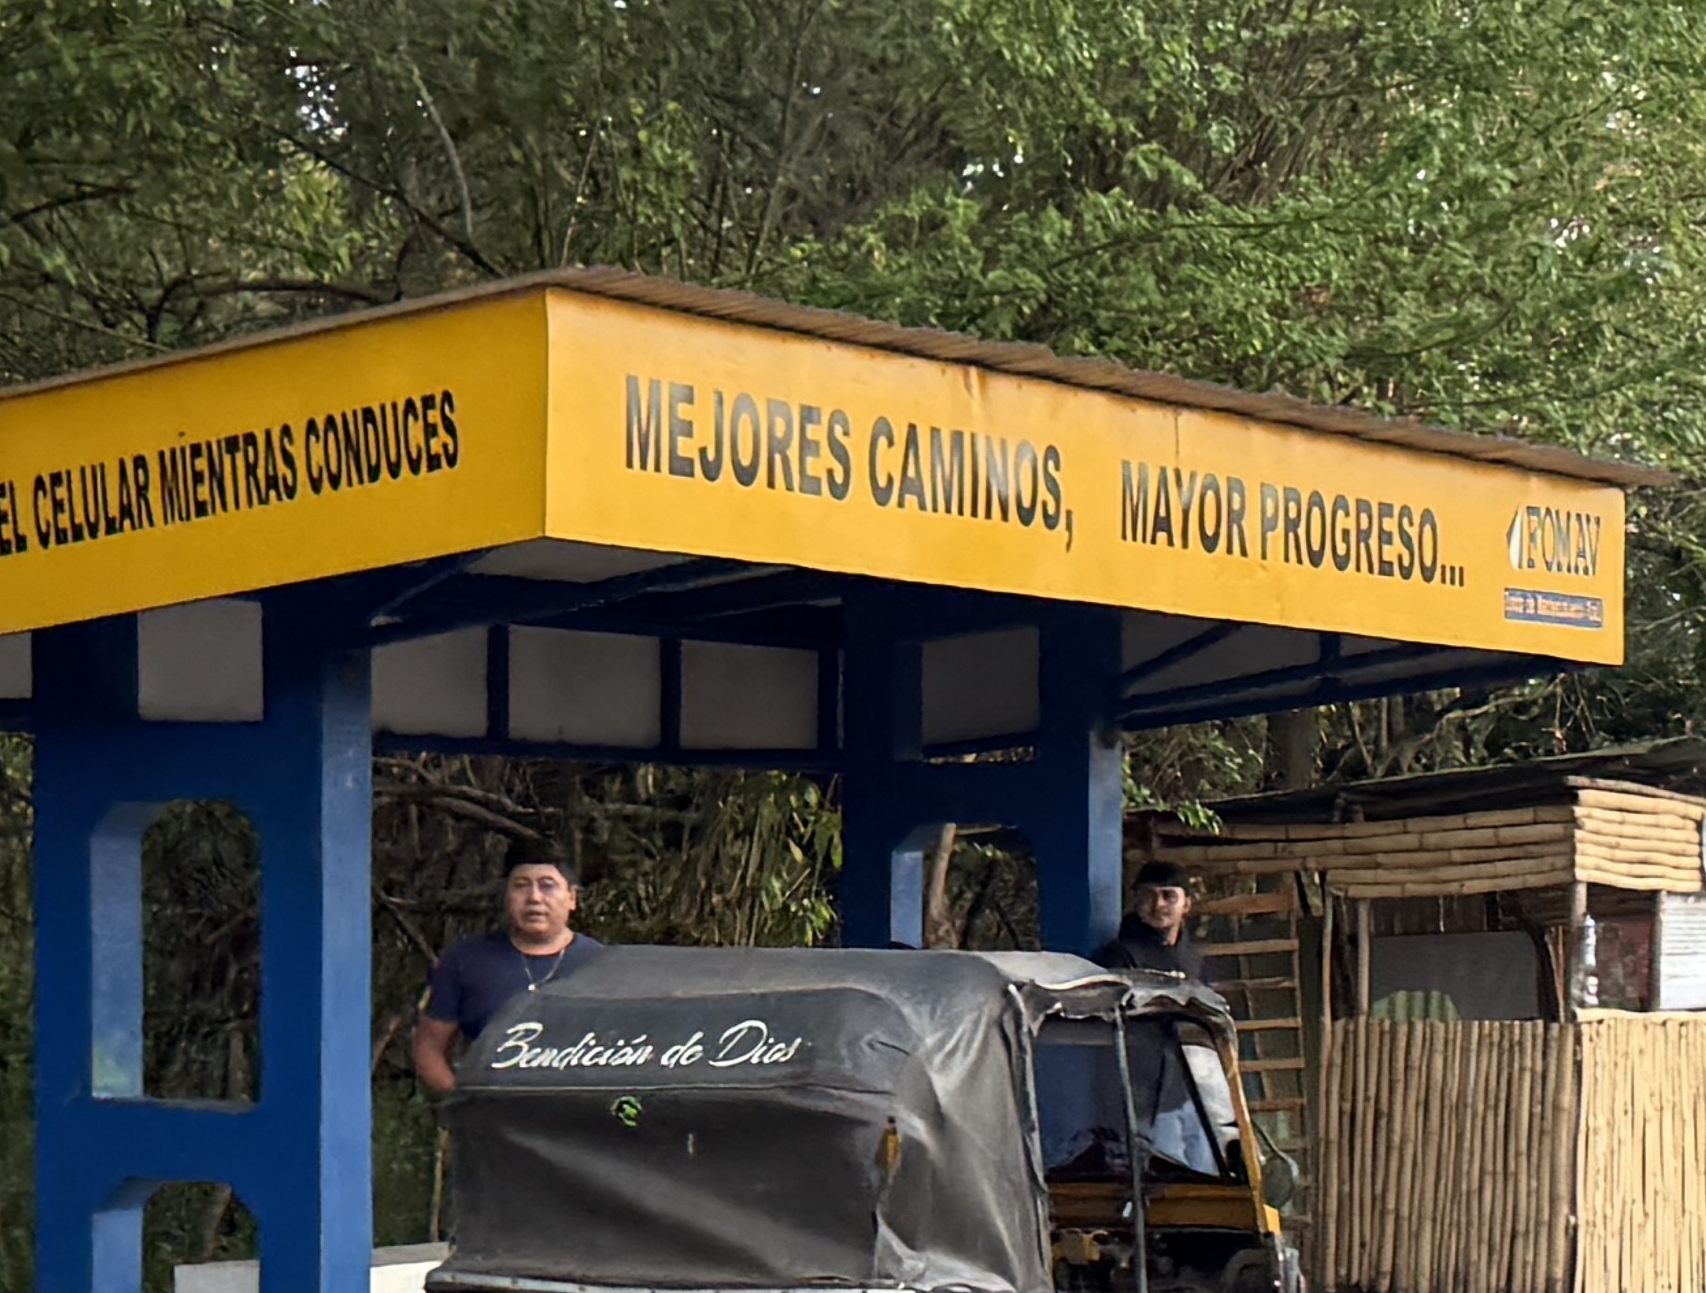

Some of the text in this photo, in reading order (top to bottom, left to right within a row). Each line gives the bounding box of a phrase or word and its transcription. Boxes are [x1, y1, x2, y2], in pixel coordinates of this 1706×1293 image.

[33, 454, 154, 550] CELULAR
[158, 423, 297, 526] MIENTRAS
[305, 390, 459, 495] CONDUCES
[625, 374, 1464, 587] MEJORES CAMINOS, MAYOR PROGRESO...
[491, 1019, 802, 1070] Bendición de Dios
